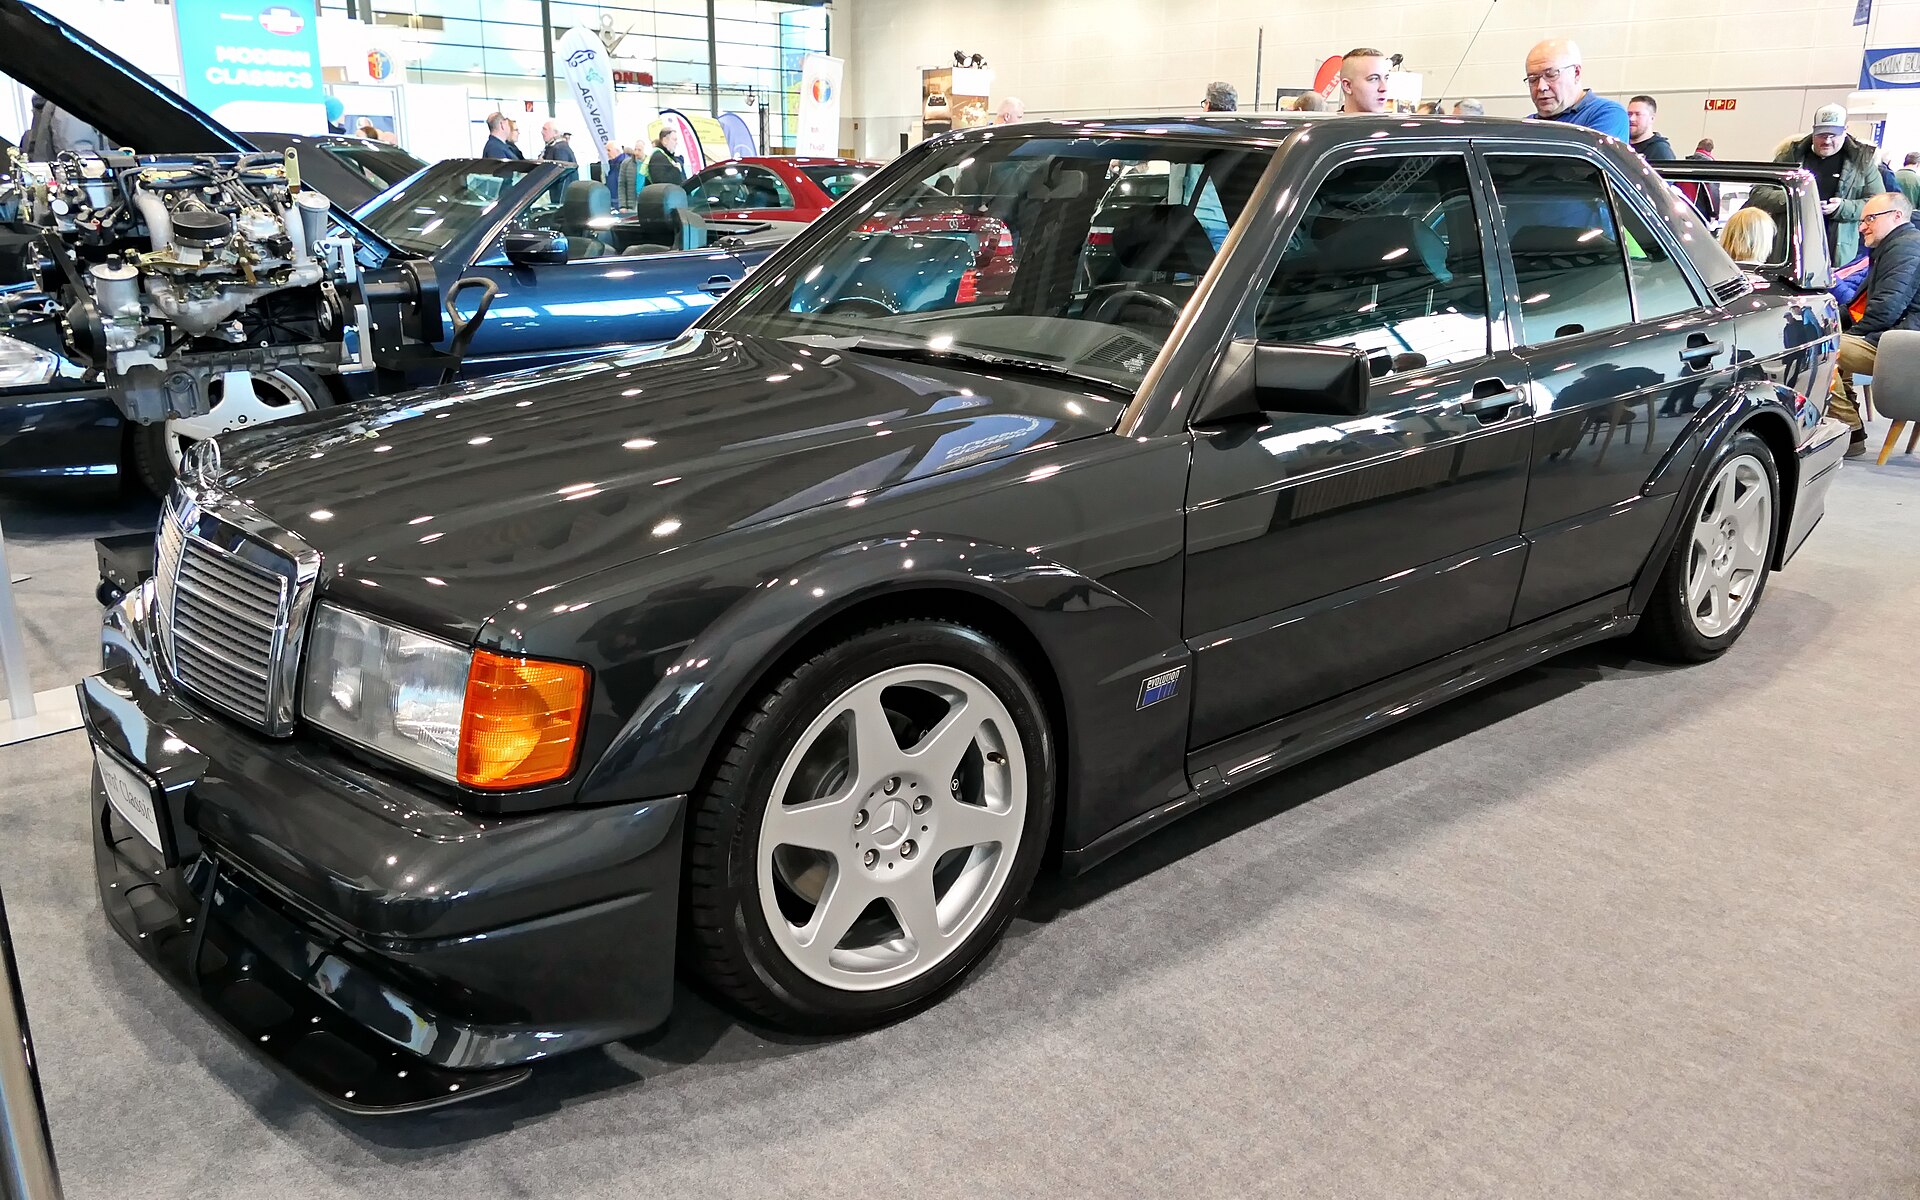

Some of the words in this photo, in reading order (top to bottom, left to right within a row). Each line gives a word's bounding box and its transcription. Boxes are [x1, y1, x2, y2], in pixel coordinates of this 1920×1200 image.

[215, 45, 311, 68] MODERN
[205, 66, 313, 89] CLASSICS
[590, 107, 609, 146] Verde
